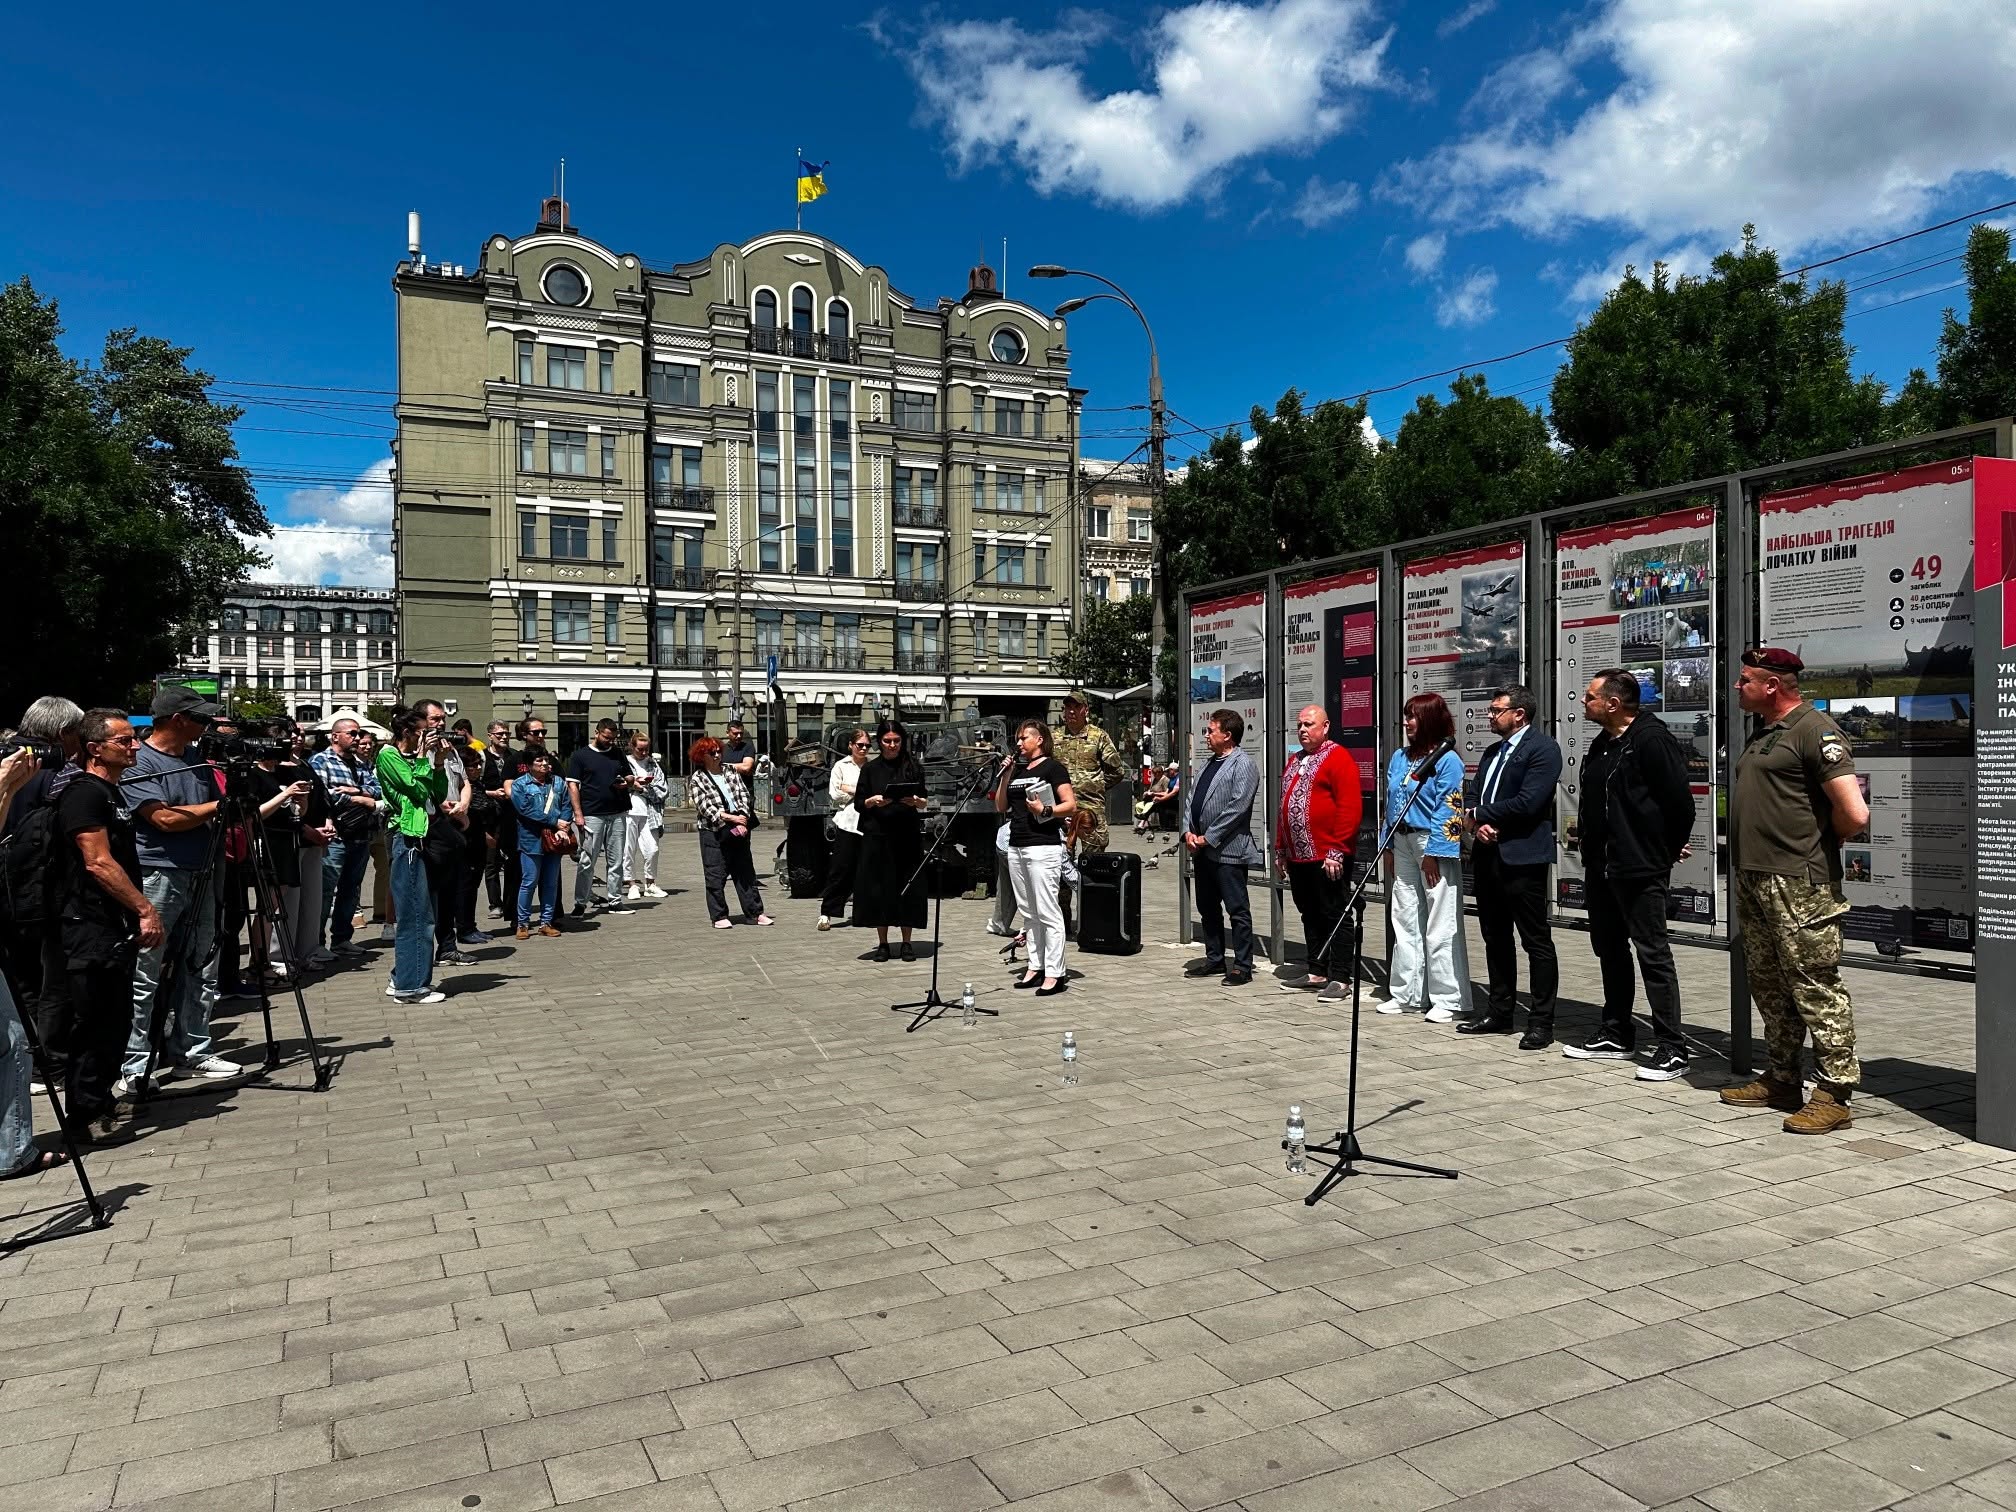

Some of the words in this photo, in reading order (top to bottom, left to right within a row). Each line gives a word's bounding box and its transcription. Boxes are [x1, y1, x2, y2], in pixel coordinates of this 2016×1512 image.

[1766, 530, 1833, 552] НАЙБІЛЬША
[1837, 519, 1895, 542] ТРАГЕДІЯ
[1766, 549, 1816, 570] ПОЧАТКУ
[1821, 543, 1858, 563] ВІЙНИ
[1561, 560, 1577, 570] АТО,
[1911, 555, 1943, 581] 49
[1561, 567, 1598, 580] ОКУПАЦІЯ,
[1561, 577, 1602, 591] ВЕЛИКДЕНЬ
[1910, 582, 1942, 591] загиблих
[1407, 590, 1427, 600] СХІДНА
[1428, 586, 1448, 597] БРАМА
[1920, 591, 1965, 602] десантників
[1926, 602, 1951, 610] ОПДБр
[1287, 612, 1314, 625] ІСТОРІЯ,
[1910, 617, 1915, 625] 9
[1916, 615, 1940, 624] членів
[1941, 613, 1971, 623] екіпажу
[1287, 624, 1300, 634] ЯКА
[1287, 630, 1321, 644] ПОЧАЛАСЯ
[1293, 643, 1316, 655] 2013-МУ
[1997, 663, 2016, 673] УК
[1997, 678, 2016, 688] ІН
[1244, 708, 1257, 719] 196
[1977, 752, 2015, 761] Український
[1977, 776, 2001, 785] України
[1977, 785, 2003, 793] Інститут
[1977, 826, 2007, 834] наслідків
[1978, 891, 2008, 899] Площини
